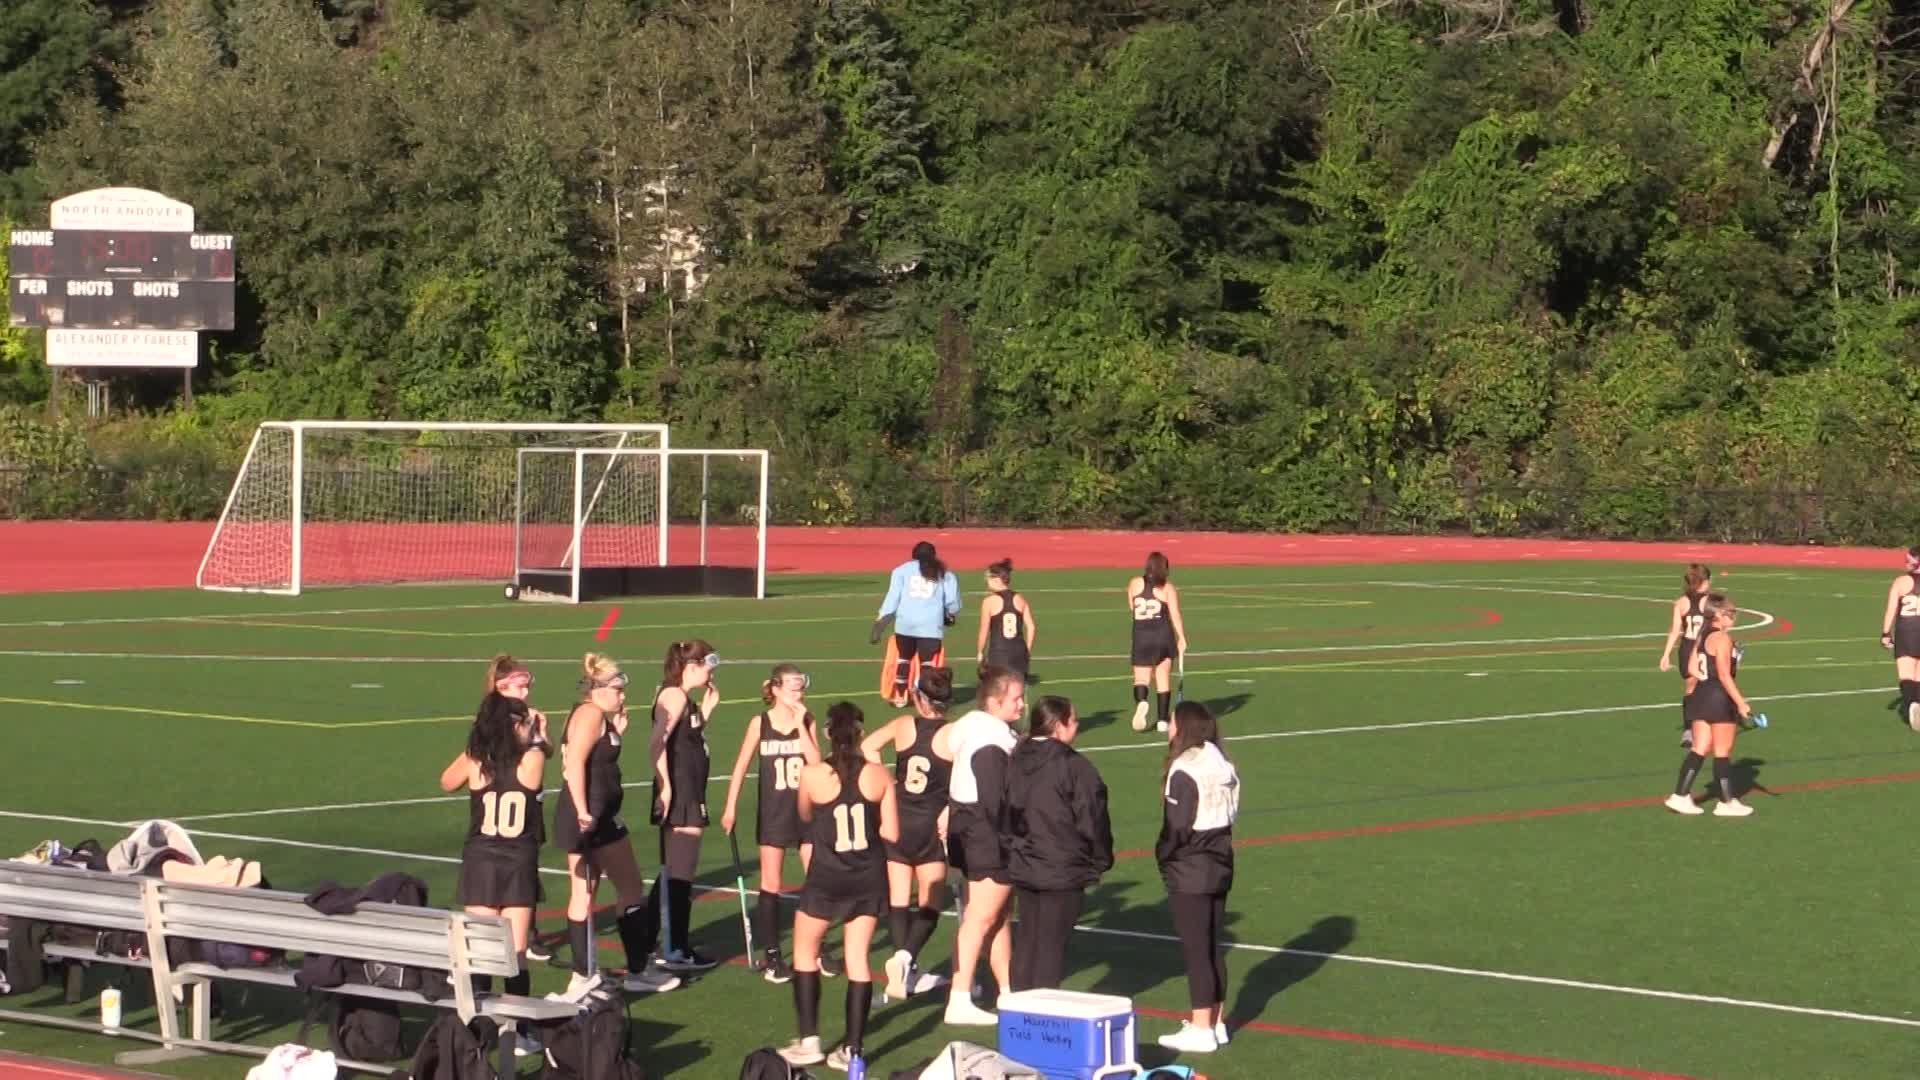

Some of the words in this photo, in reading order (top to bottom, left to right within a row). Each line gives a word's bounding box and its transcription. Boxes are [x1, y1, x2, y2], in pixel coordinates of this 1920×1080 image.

[61, 205, 110, 217] NORTH
[116, 206, 184, 217] ANDOVER
[11, 231, 54, 246] HOME
[190, 235, 233, 250] GUEST
[19, 280, 48, 294] PER
[67, 281, 114, 296] SHOTS
[133, 282, 180, 297] SHOTS
[55, 333, 128, 345] ALEXANDER
[144, 334, 189, 346] FARESE
[1002, 613, 1017, 639] 8
[904, 756, 931, 794] 6
[480, 790, 527, 838] 10
[833, 803, 868, 853] 11
